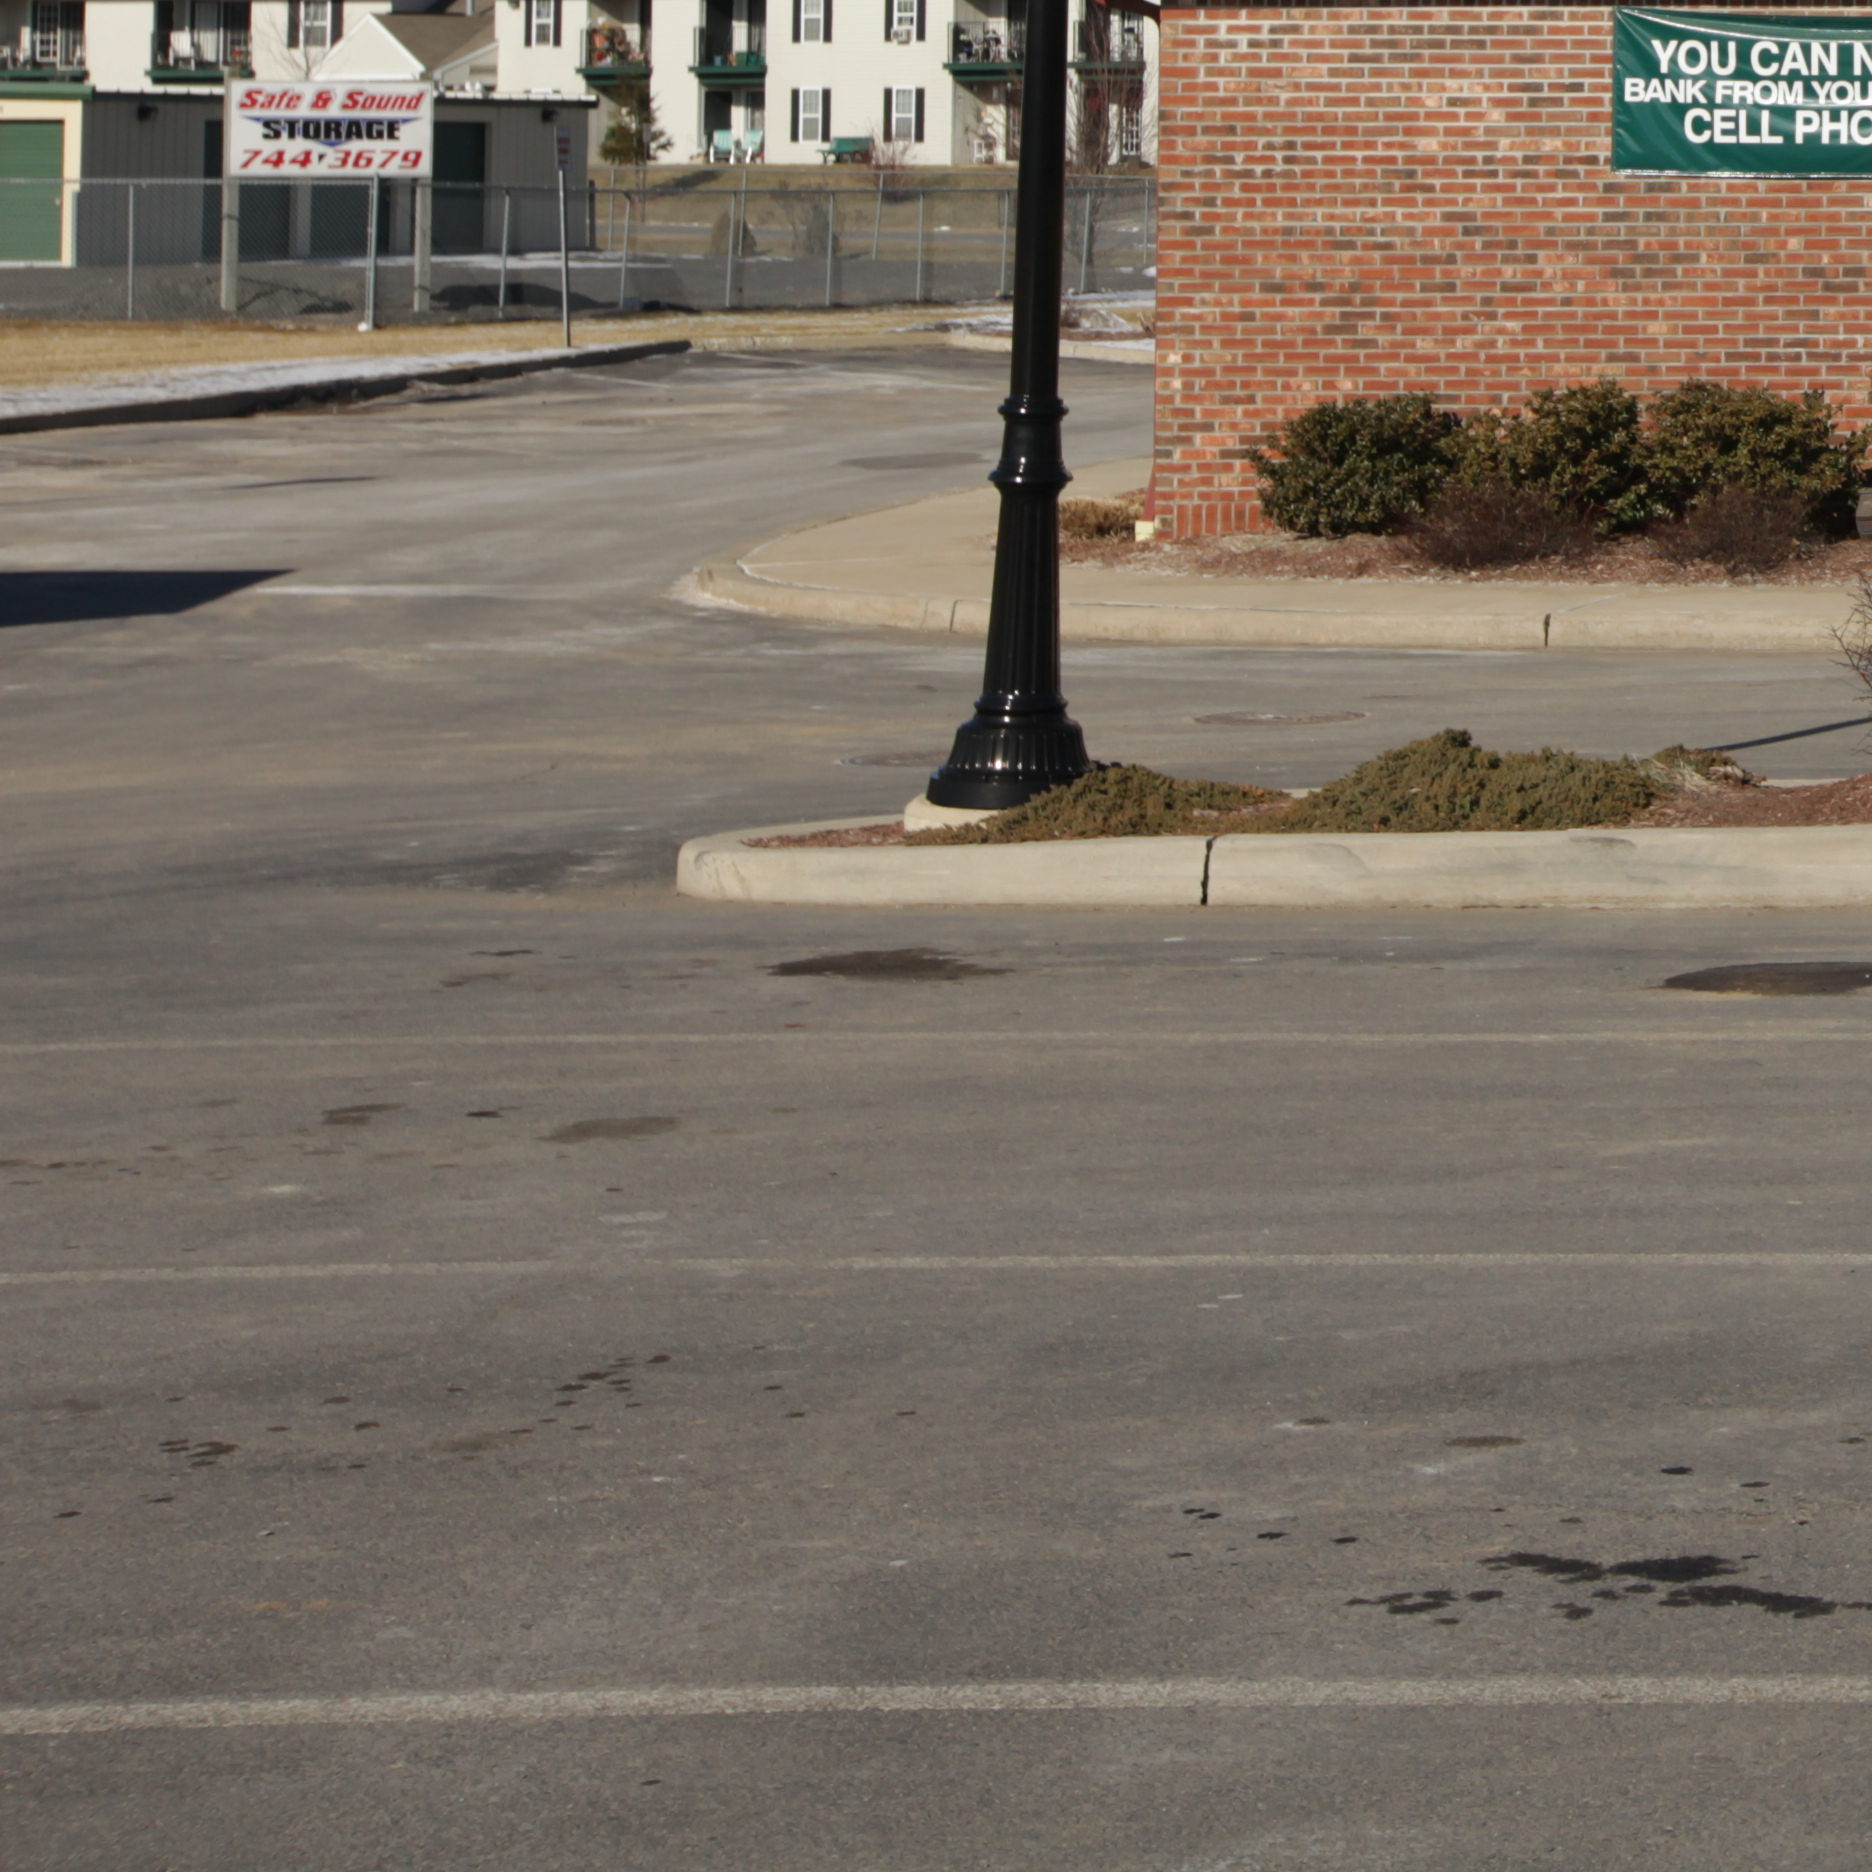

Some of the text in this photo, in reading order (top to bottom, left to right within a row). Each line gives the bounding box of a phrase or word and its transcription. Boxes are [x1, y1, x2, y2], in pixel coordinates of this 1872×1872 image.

[1651, 39, 1738, 77] YOU
[1750, 39, 1851, 76] CAN
[239, 88, 427, 111] Safe & Sound
[1623, 77, 1707, 103] BANK
[1715, 80, 1803, 105] FROM
[262, 120, 401, 140] STORAGE
[1684, 108, 1784, 144] CELL
